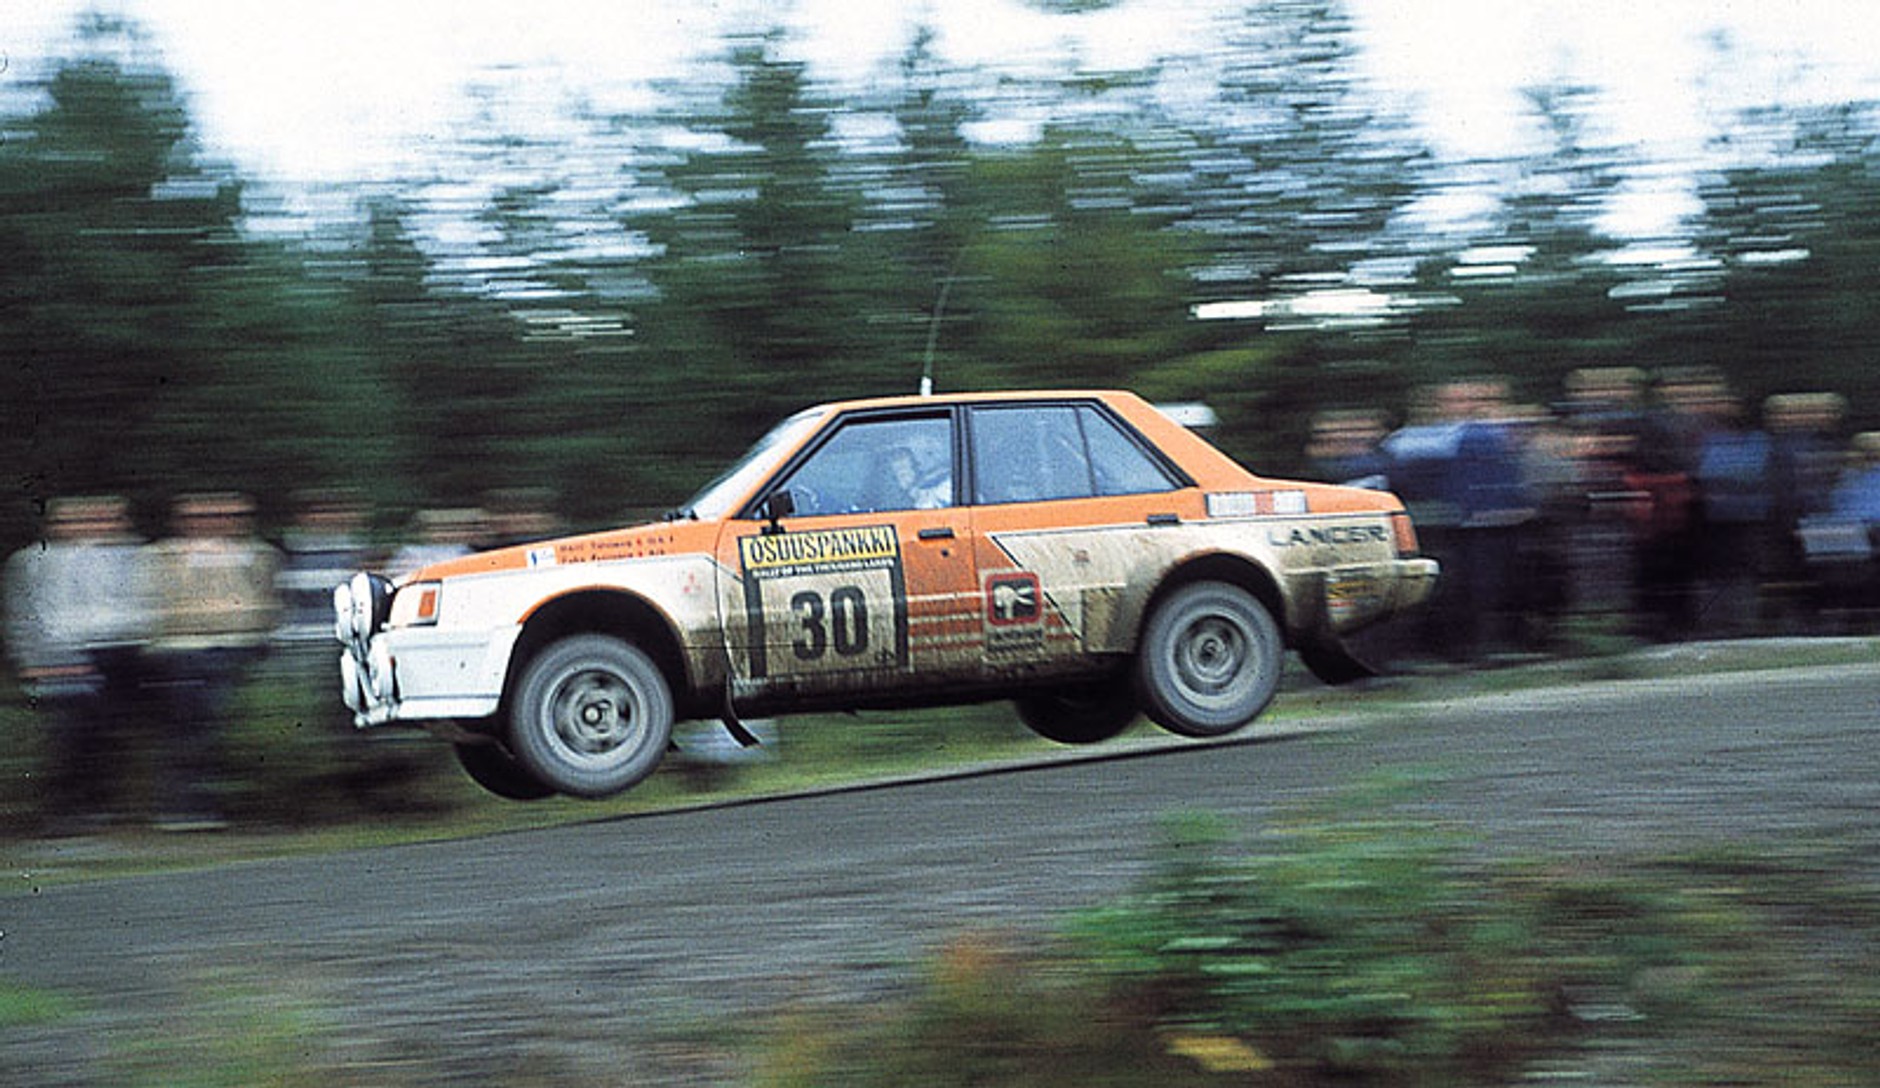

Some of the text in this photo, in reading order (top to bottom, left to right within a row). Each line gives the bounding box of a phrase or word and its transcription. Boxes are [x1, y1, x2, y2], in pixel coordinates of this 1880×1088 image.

[750, 529, 892, 563] OSUUSPANKKI
[1267, 525, 1387, 547] LANCER
[791, 585, 868, 660] 30
